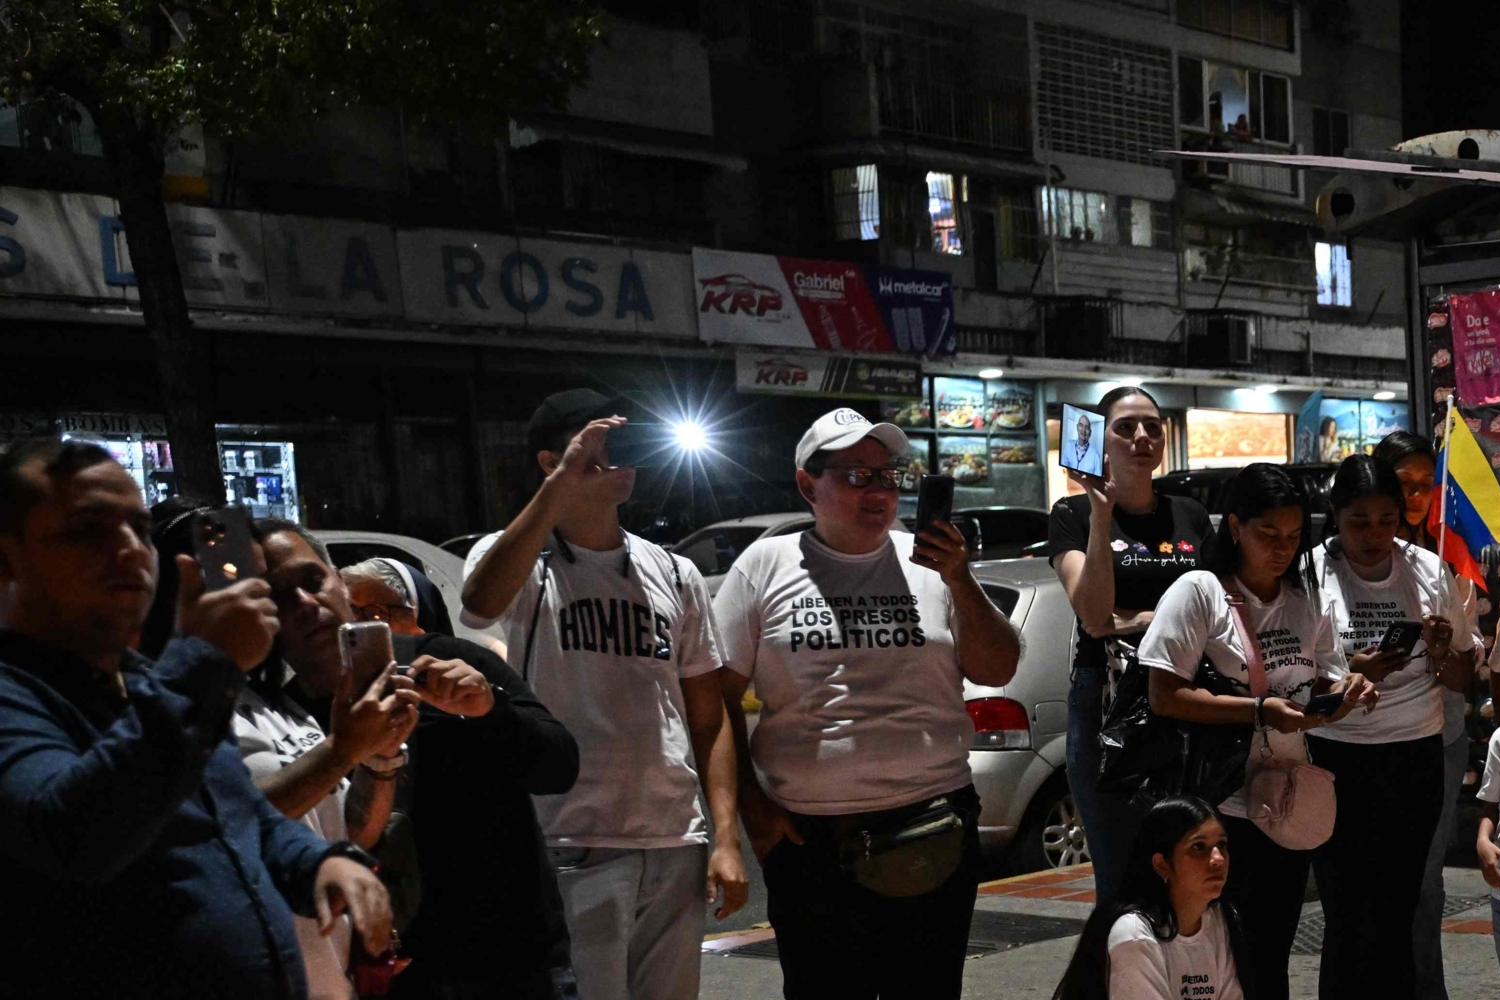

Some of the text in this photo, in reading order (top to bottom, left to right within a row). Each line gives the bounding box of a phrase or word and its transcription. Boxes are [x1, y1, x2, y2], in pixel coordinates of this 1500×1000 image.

[440, 243, 655, 322] ROSA
[793, 271, 844, 292] Gabriel
[893, 278, 945, 297] metalcar
[700, 289, 783, 316] KRP
[754, 366, 809, 386] KRP
[64, 414, 165, 433] BOMBAS
[1121, 554, 1152, 566] Have
[1160, 553, 1178, 566] good
[1178, 554, 1196, 567] day
[792, 594, 919, 610] LIBEREN A TODOS
[792, 608, 921, 628] LOS PRESOS
[1348, 620, 1367, 628] LOS
[1350, 611, 1407, 619] PARA TODOS
[559, 597, 671, 661] HOMIES
[1339, 631, 1375, 640] PRESOS
[790, 626, 926, 653] POLÍTICOS
[1274, 636, 1300, 647] TODOS
[1269, 646, 1302, 660] PRESOS
